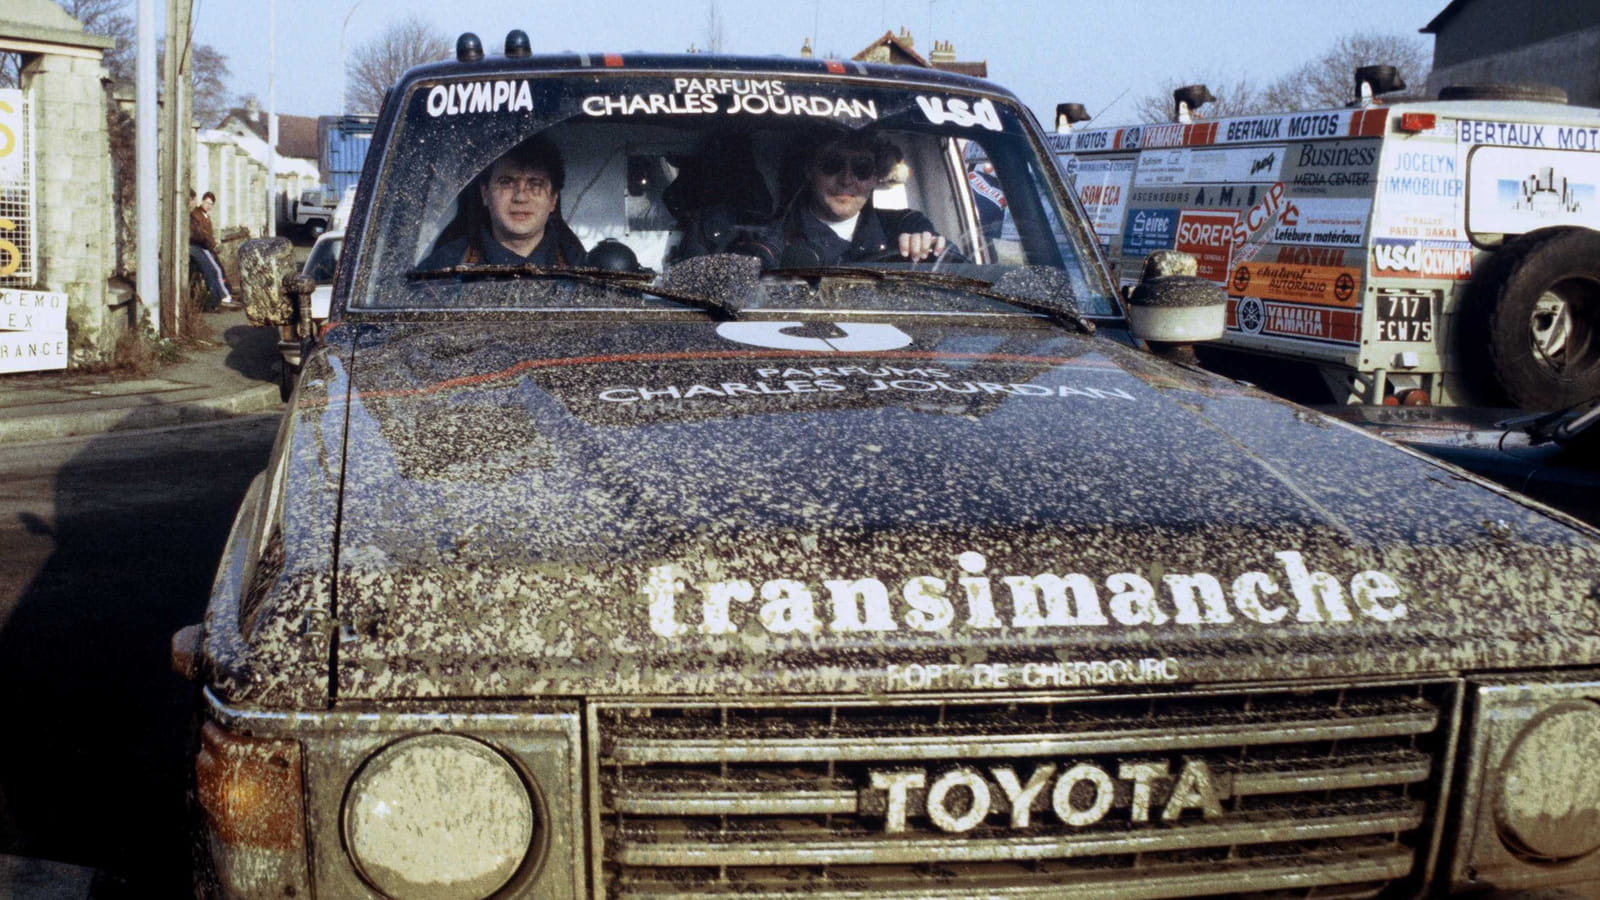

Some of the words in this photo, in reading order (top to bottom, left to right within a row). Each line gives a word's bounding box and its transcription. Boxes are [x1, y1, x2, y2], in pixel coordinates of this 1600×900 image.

[674, 78, 785, 96] PARFUMS
[427, 80, 534, 118] OLYMPIA
[582, 94, 719, 117] CHARLES
[727, 94, 878, 120] JOURDAN
[1144, 125, 1185, 148] YAMAHA
[1227, 118, 1282, 141] BERTAUX
[1288, 114, 1339, 138] MOTOS
[1461, 120, 1544, 146] BERTAUX
[1076, 132, 1108, 149] MOTOS
[1298, 142, 1376, 167] Business
[1395, 152, 1455, 173] JOCELYN
[1294, 172, 1326, 186] MEDIA
[1328, 171, 1370, 187] CENTER
[1384, 177, 1463, 198] IMMOBILIER
[1132, 191, 1190, 202] ASCENSEURS
[1314, 230, 1361, 245] matériaux
[1424, 249, 1472, 276] OLYMPIA
[1388, 297, 1420, 318] 717
[1267, 306, 1324, 337] YAMAHA
[1411, 321, 1432, 342] 75
[757, 366, 951, 380] PARFUMS
[598, 377, 846, 403] CHARLES
[866, 378, 1138, 402] JOURDAN
[643, 549, 1409, 639] transimanche
[974, 663, 1009, 687] DE
[868, 757, 1226, 835] TOYOTA
